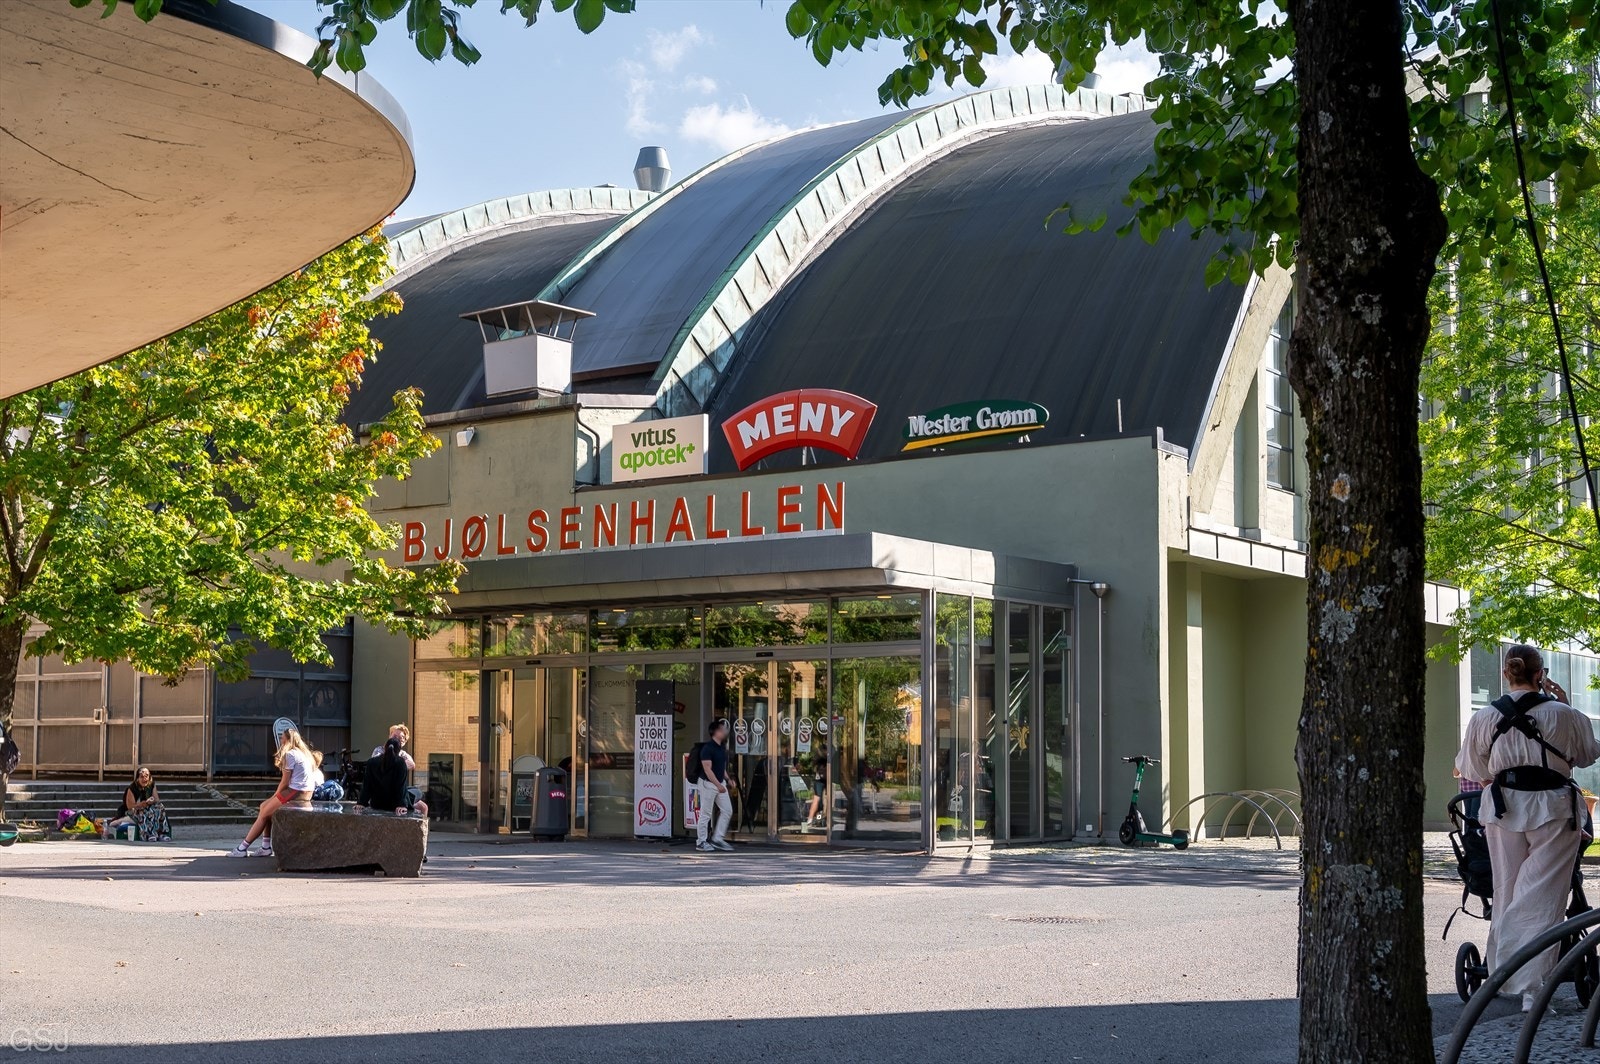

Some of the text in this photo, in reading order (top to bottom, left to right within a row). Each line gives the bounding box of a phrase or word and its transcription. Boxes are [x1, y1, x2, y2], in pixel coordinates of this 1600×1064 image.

[737, 402, 855, 449] MENY
[908, 406, 1038, 437] Mester Grønn
[631, 428, 676, 448] vitus
[404, 481, 846, 563] BJØLSENHALLEN
[640, 716, 667, 727] SI JA TIL
[640, 727, 667, 740] STORT
[640, 740, 667, 751] UTVALG
[647, 751, 667, 762] FERSKE
